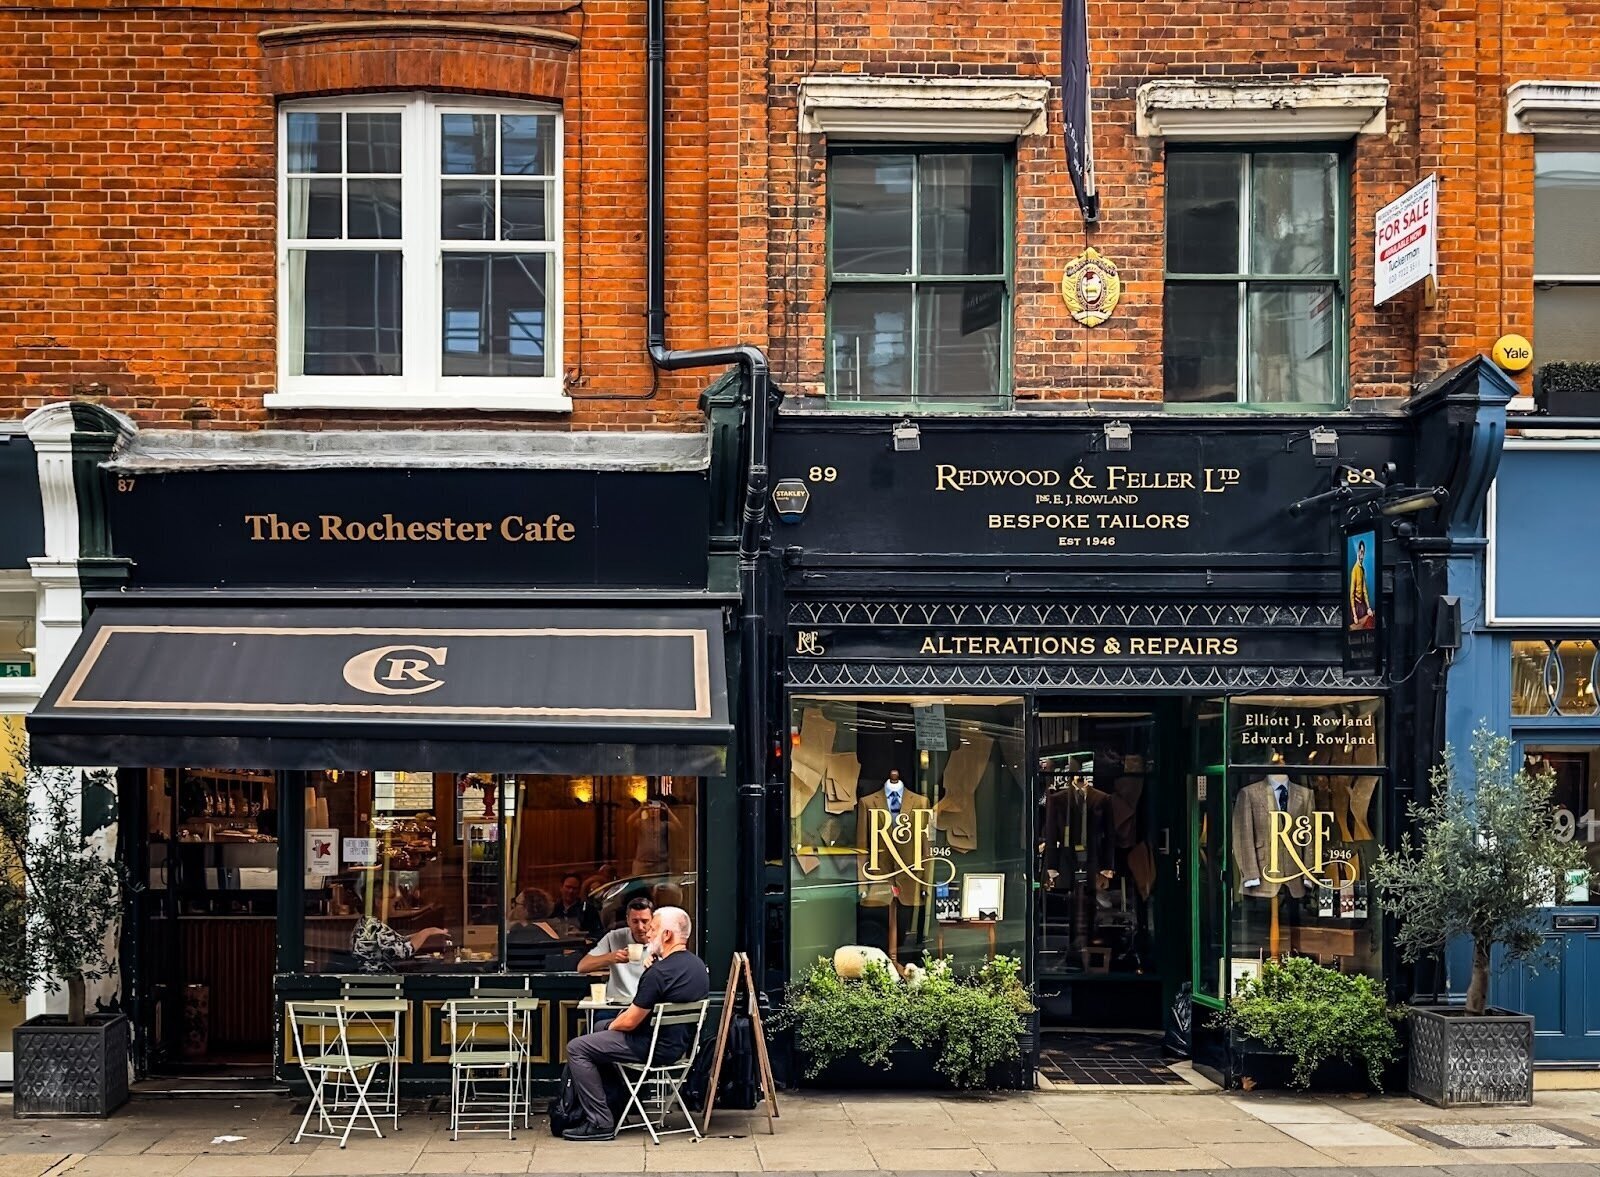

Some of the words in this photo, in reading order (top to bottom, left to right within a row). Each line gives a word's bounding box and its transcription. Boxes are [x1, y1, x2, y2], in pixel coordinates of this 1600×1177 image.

[1378, 218, 1400, 246] FOR
[1403, 198, 1429, 230] SALE
[1388, 247, 1420, 272] Tuckerman
[1503, 347, 1529, 359] Yale
[808, 466, 837, 482] 89
[1069, 465, 1097, 490] &
[1106, 465, 1196, 491] FELLER
[117, 479, 135, 492] 87
[1053, 494, 1063, 505] E.
[1065, 494, 1073, 507] J.
[1075, 494, 1139, 505] ROWLAND
[245, 513, 310, 541] The
[318, 513, 492, 542] Rochester
[500, 513, 577, 543] Cafe
[988, 514, 1090, 529] BESPOKE
[1096, 514, 1190, 529] TAILORS
[1086, 536, 1116, 546] 1946
[795, 631, 825, 656] R&F
[919, 636, 1096, 655] ALTERATIONS
[1103, 636, 1122, 655] &
[1129, 636, 1239, 655] REPAIRS
[1245, 713, 1289, 726] Elliott
[1294, 714, 1306, 729] J.
[1313, 714, 1372, 727] Rowland
[1241, 731, 1293, 744] Edward
[1297, 732, 1309, 747] J.
[1315, 732, 1376, 745] Rowland
[1553, 808, 1596, 843] 91
[863, 808, 956, 886] R&F
[929, 846, 951, 857] 1946
[1262, 811, 1357, 890] R&F
[1329, 849, 1352, 859] 1946
